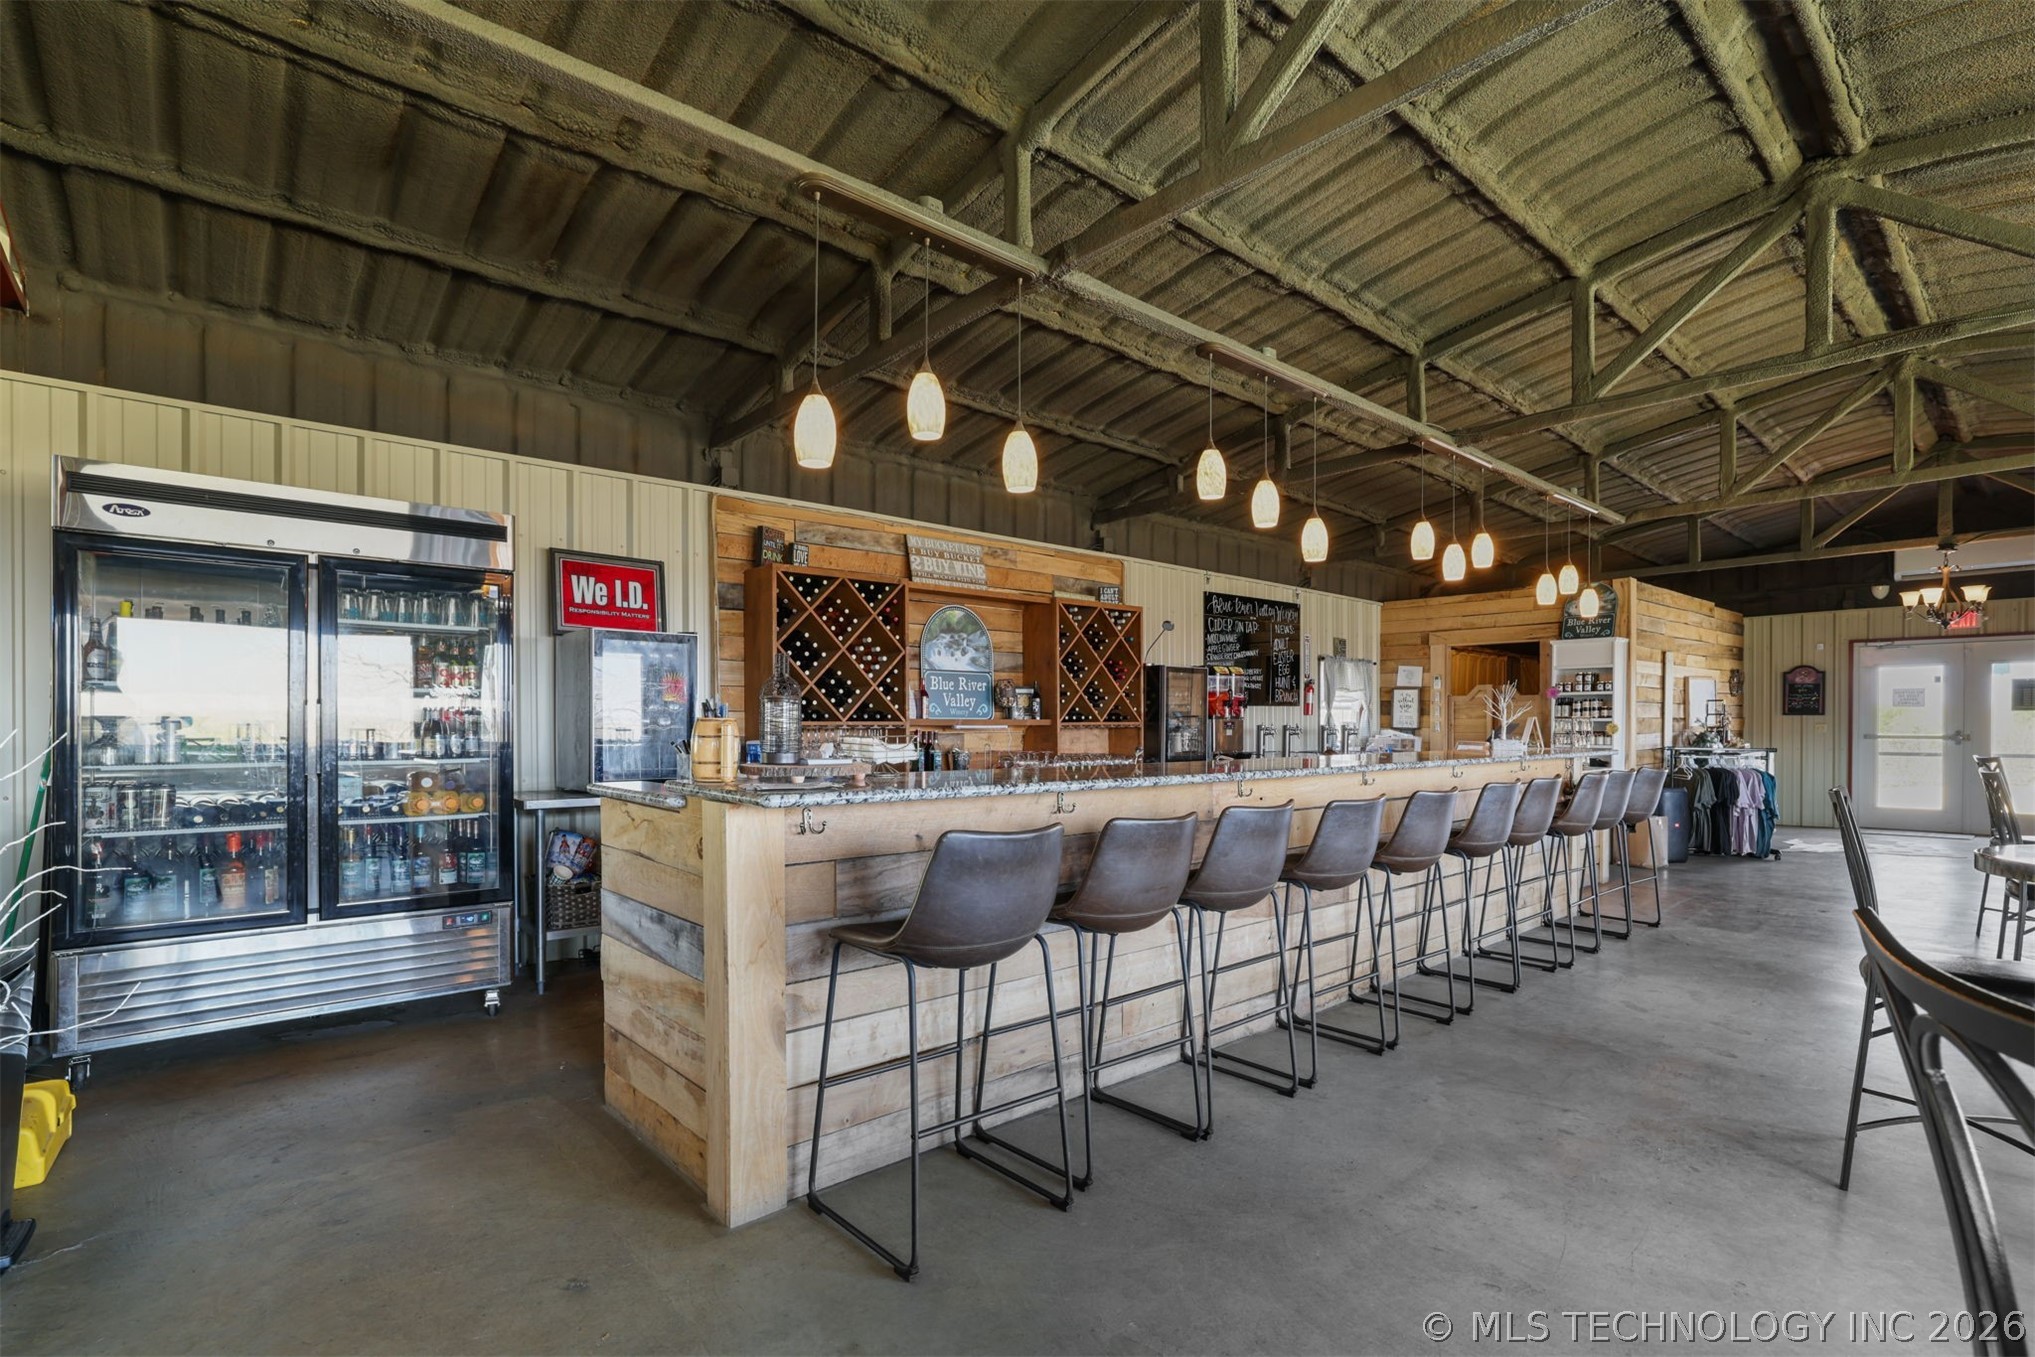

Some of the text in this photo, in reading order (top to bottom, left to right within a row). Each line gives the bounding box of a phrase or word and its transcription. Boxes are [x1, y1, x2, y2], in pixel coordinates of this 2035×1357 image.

[909, 536, 982, 557] MY BUCKET LIST
[763, 550, 784, 563] DRINK
[793, 550, 808, 564] LOVE
[920, 548, 941, 558] BUY
[944, 552, 981, 563] BUCKET
[911, 556, 987, 579] 2 BUY WINE
[571, 574, 649, 610] We I.D.
[1208, 617, 1233, 632] CIDER
[1567, 617, 1611, 627] Blue River
[1576, 626, 1601, 635] Valley
[1273, 649, 1294, 665] EASTER
[1278, 664, 1290, 676] EGG
[930, 676, 987, 691] Blue River
[1275, 676, 1291, 690] HUNT
[943, 692, 976, 711] Valley
[1275, 689, 1298, 703] BRUNCH
